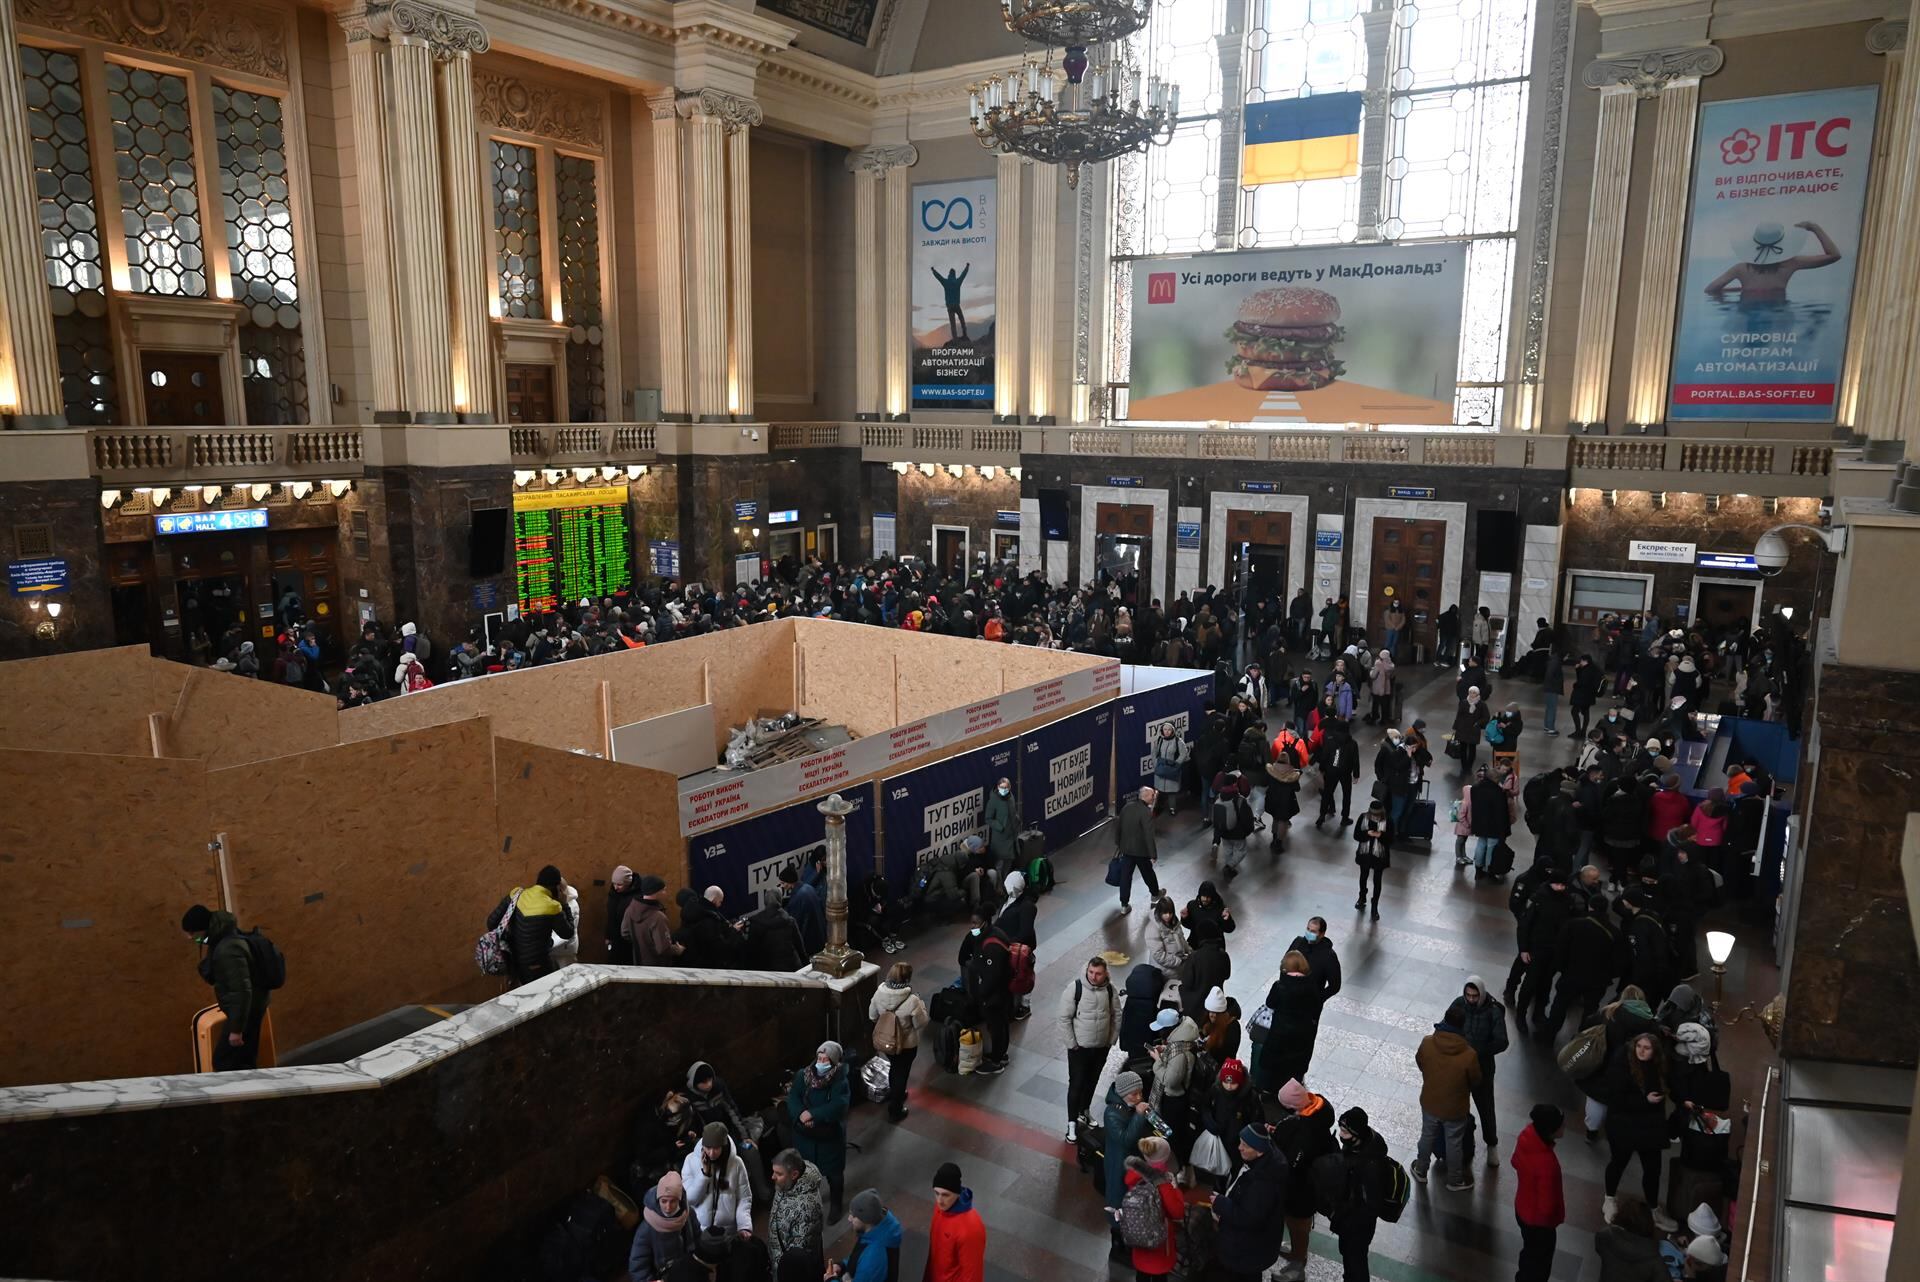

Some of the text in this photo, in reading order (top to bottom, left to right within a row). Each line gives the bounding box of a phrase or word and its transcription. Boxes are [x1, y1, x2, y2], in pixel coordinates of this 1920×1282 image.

[1715, 168, 1844, 186] ВИ ВІДПОЧИВАЄТЕ,
[1716, 182, 1839, 199] А БІЗНЕС ПРАЦЮЄ
[921, 239, 950, 247] ЗАВЖДИ
[962, 236, 987, 244] ВИСОТІ
[1181, 272, 1201, 285] Усі
[1204, 271, 1257, 286] дороги
[1261, 269, 1312, 284] ведуть
[1315, 267, 1325, 282] у
[1720, 332, 1798, 344] СУПРОВІД
[931, 348, 974, 356] ПРОГРАМИ
[1721, 347, 1793, 358] ПРОГРАМ
[921, 356, 986, 366] АВТОМАТИЗАЦІЇ
[1694, 359, 1819, 372] АВТОМАТИЗАЦІЇ
[936, 368, 969, 377] БІЗНЕСУ
[921, 388, 985, 396] WWW.BAS-SOFT.EU
[1690, 389, 1816, 399] PORTAL.BAS-SOFT.EU
[194, 514, 216, 523] ЗАЛ
[219, 513, 233, 529] 4
[195, 523, 217, 531] HALL
[1637, 543, 1688, 552] Експрес-тест
[800, 756, 822, 769] РОБОТИ
[821, 761, 843, 775] УКРАЇНА
[1051, 748, 1089, 776] ТУТ БУДЕ
[1057, 765, 1084, 792] НОВИЙ
[689, 789, 715, 804] РОБОТИ
[714, 793, 741, 807] УКРАЇНА
[1046, 781, 1092, 815] ЕСКАЛАТОР!
[688, 802, 749, 828] ЕСКАЛАТОРИ ЛІФТИ
[927, 792, 981, 825] ТУТ БУДЕ
[934, 812, 974, 843] НОВИЙ
[752, 860, 783, 885] ТУТ
